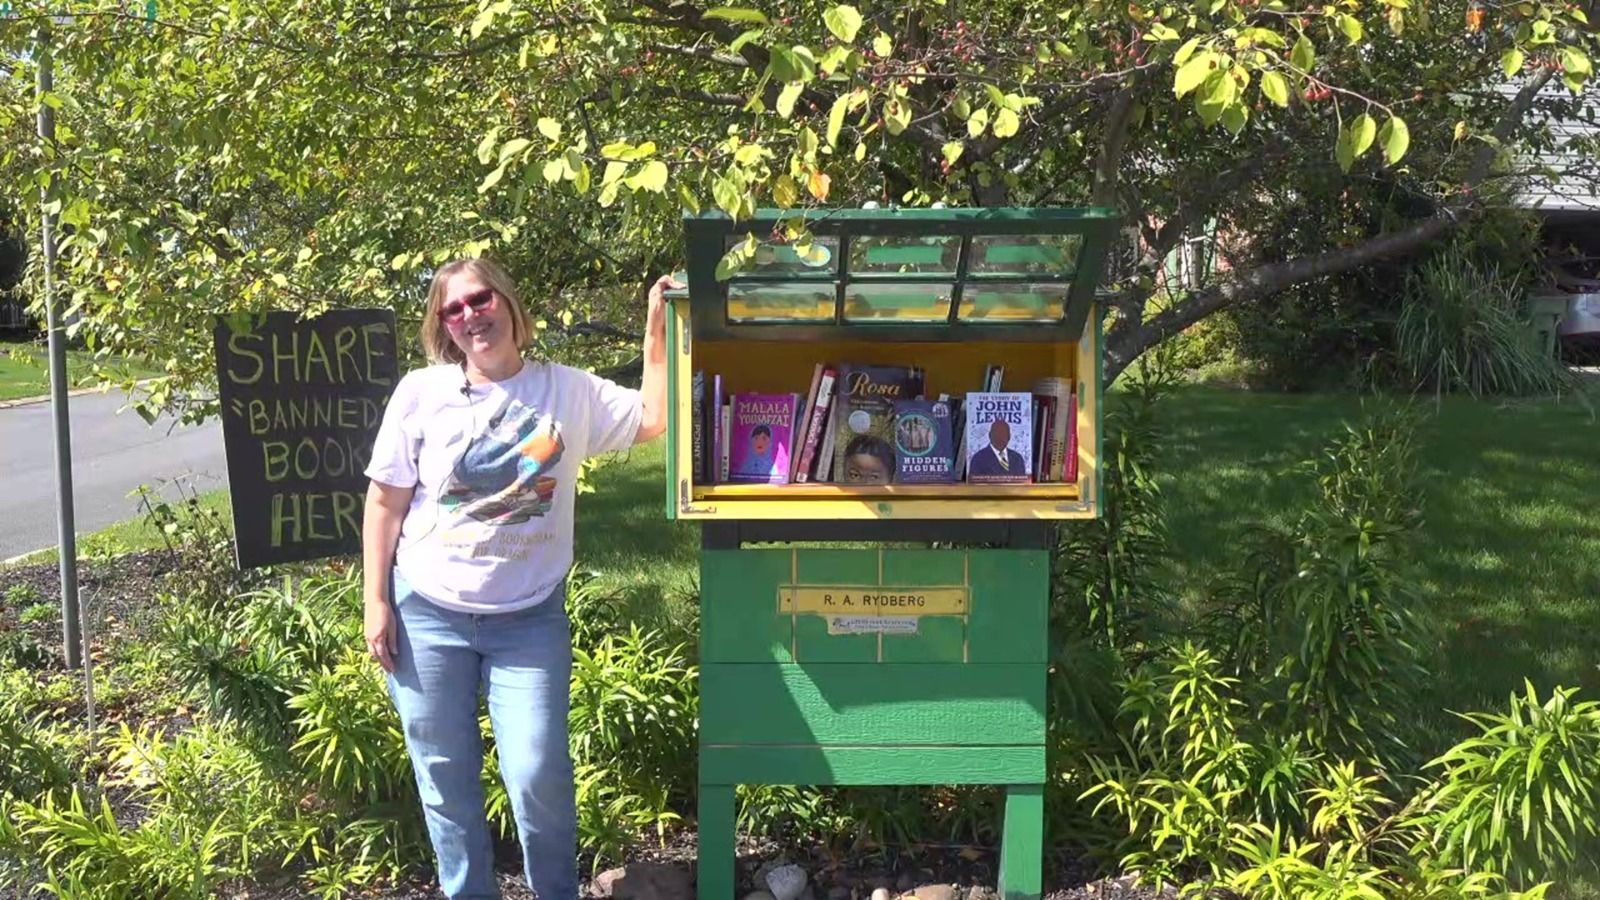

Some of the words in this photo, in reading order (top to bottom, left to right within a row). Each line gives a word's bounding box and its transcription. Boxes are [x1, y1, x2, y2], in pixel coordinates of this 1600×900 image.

[227, 322, 392, 385] SHARE
[845, 371, 901, 396] Rosa
[739, 402, 790, 414] MALALA
[976, 401, 1022, 411] JOHN
[739, 414, 790, 427] YOUSAFZAI
[976, 412, 1022, 424] LEWIS
[904, 457, 947, 465] HIDDEN
[902, 464, 949, 472] FIGURES
[824, 595, 836, 606] R.
[842, 595, 854, 606] A.
[863, 595, 925, 607] RYDBERG
